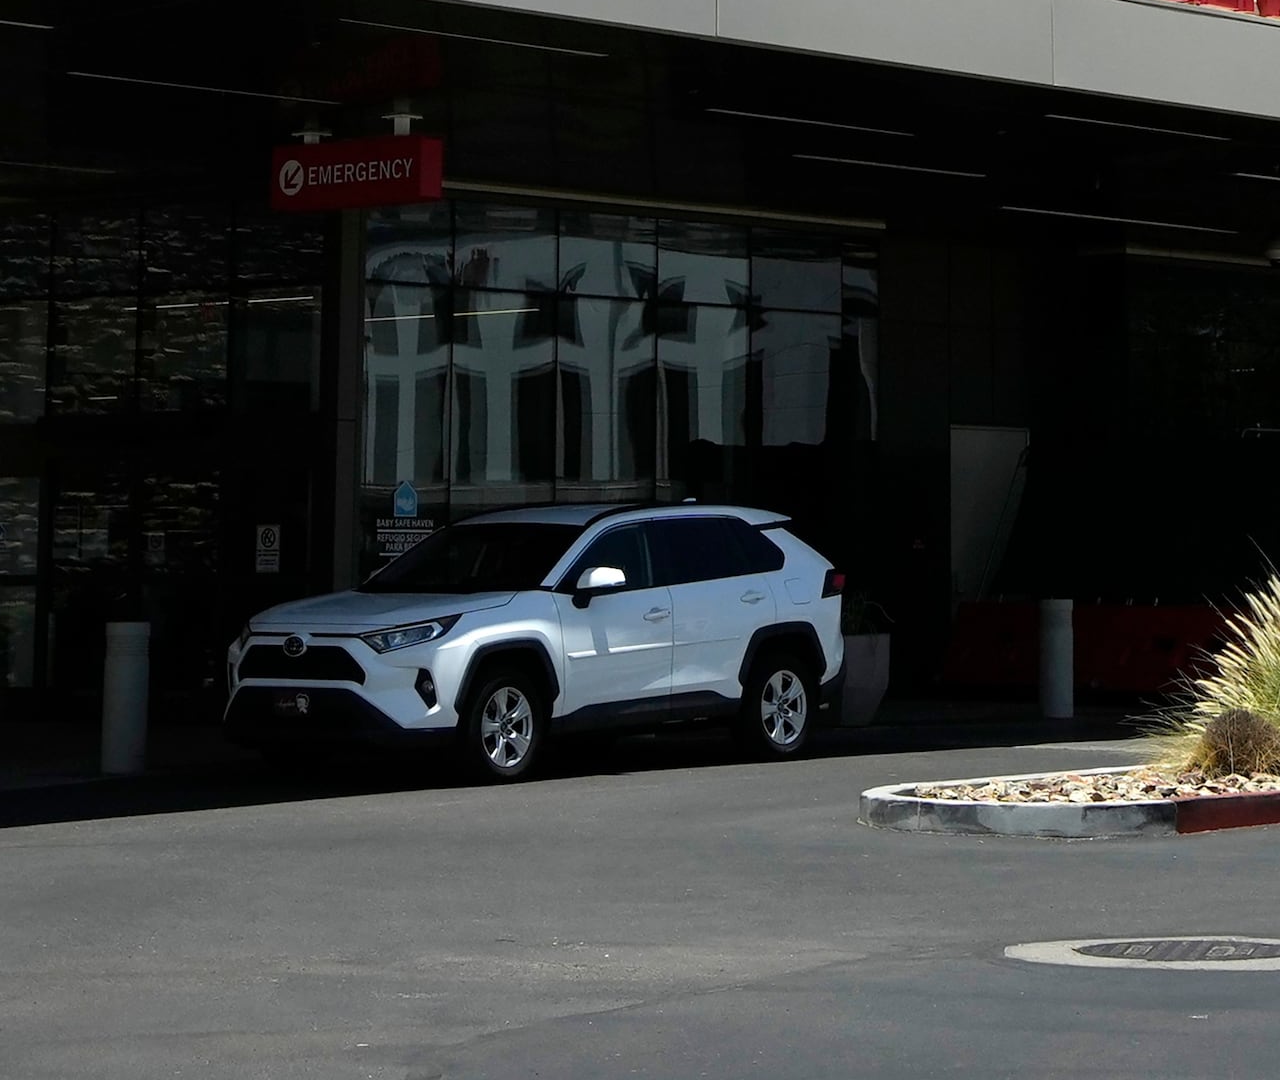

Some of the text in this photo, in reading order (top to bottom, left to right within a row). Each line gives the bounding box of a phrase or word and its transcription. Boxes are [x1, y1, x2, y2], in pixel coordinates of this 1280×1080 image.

[308, 158, 413, 186] EMERGENCY
[377, 519, 434, 528] BABY SAFE HAVEN
[377, 533, 406, 543] REFUGIO
[385, 543, 403, 551] PARA
